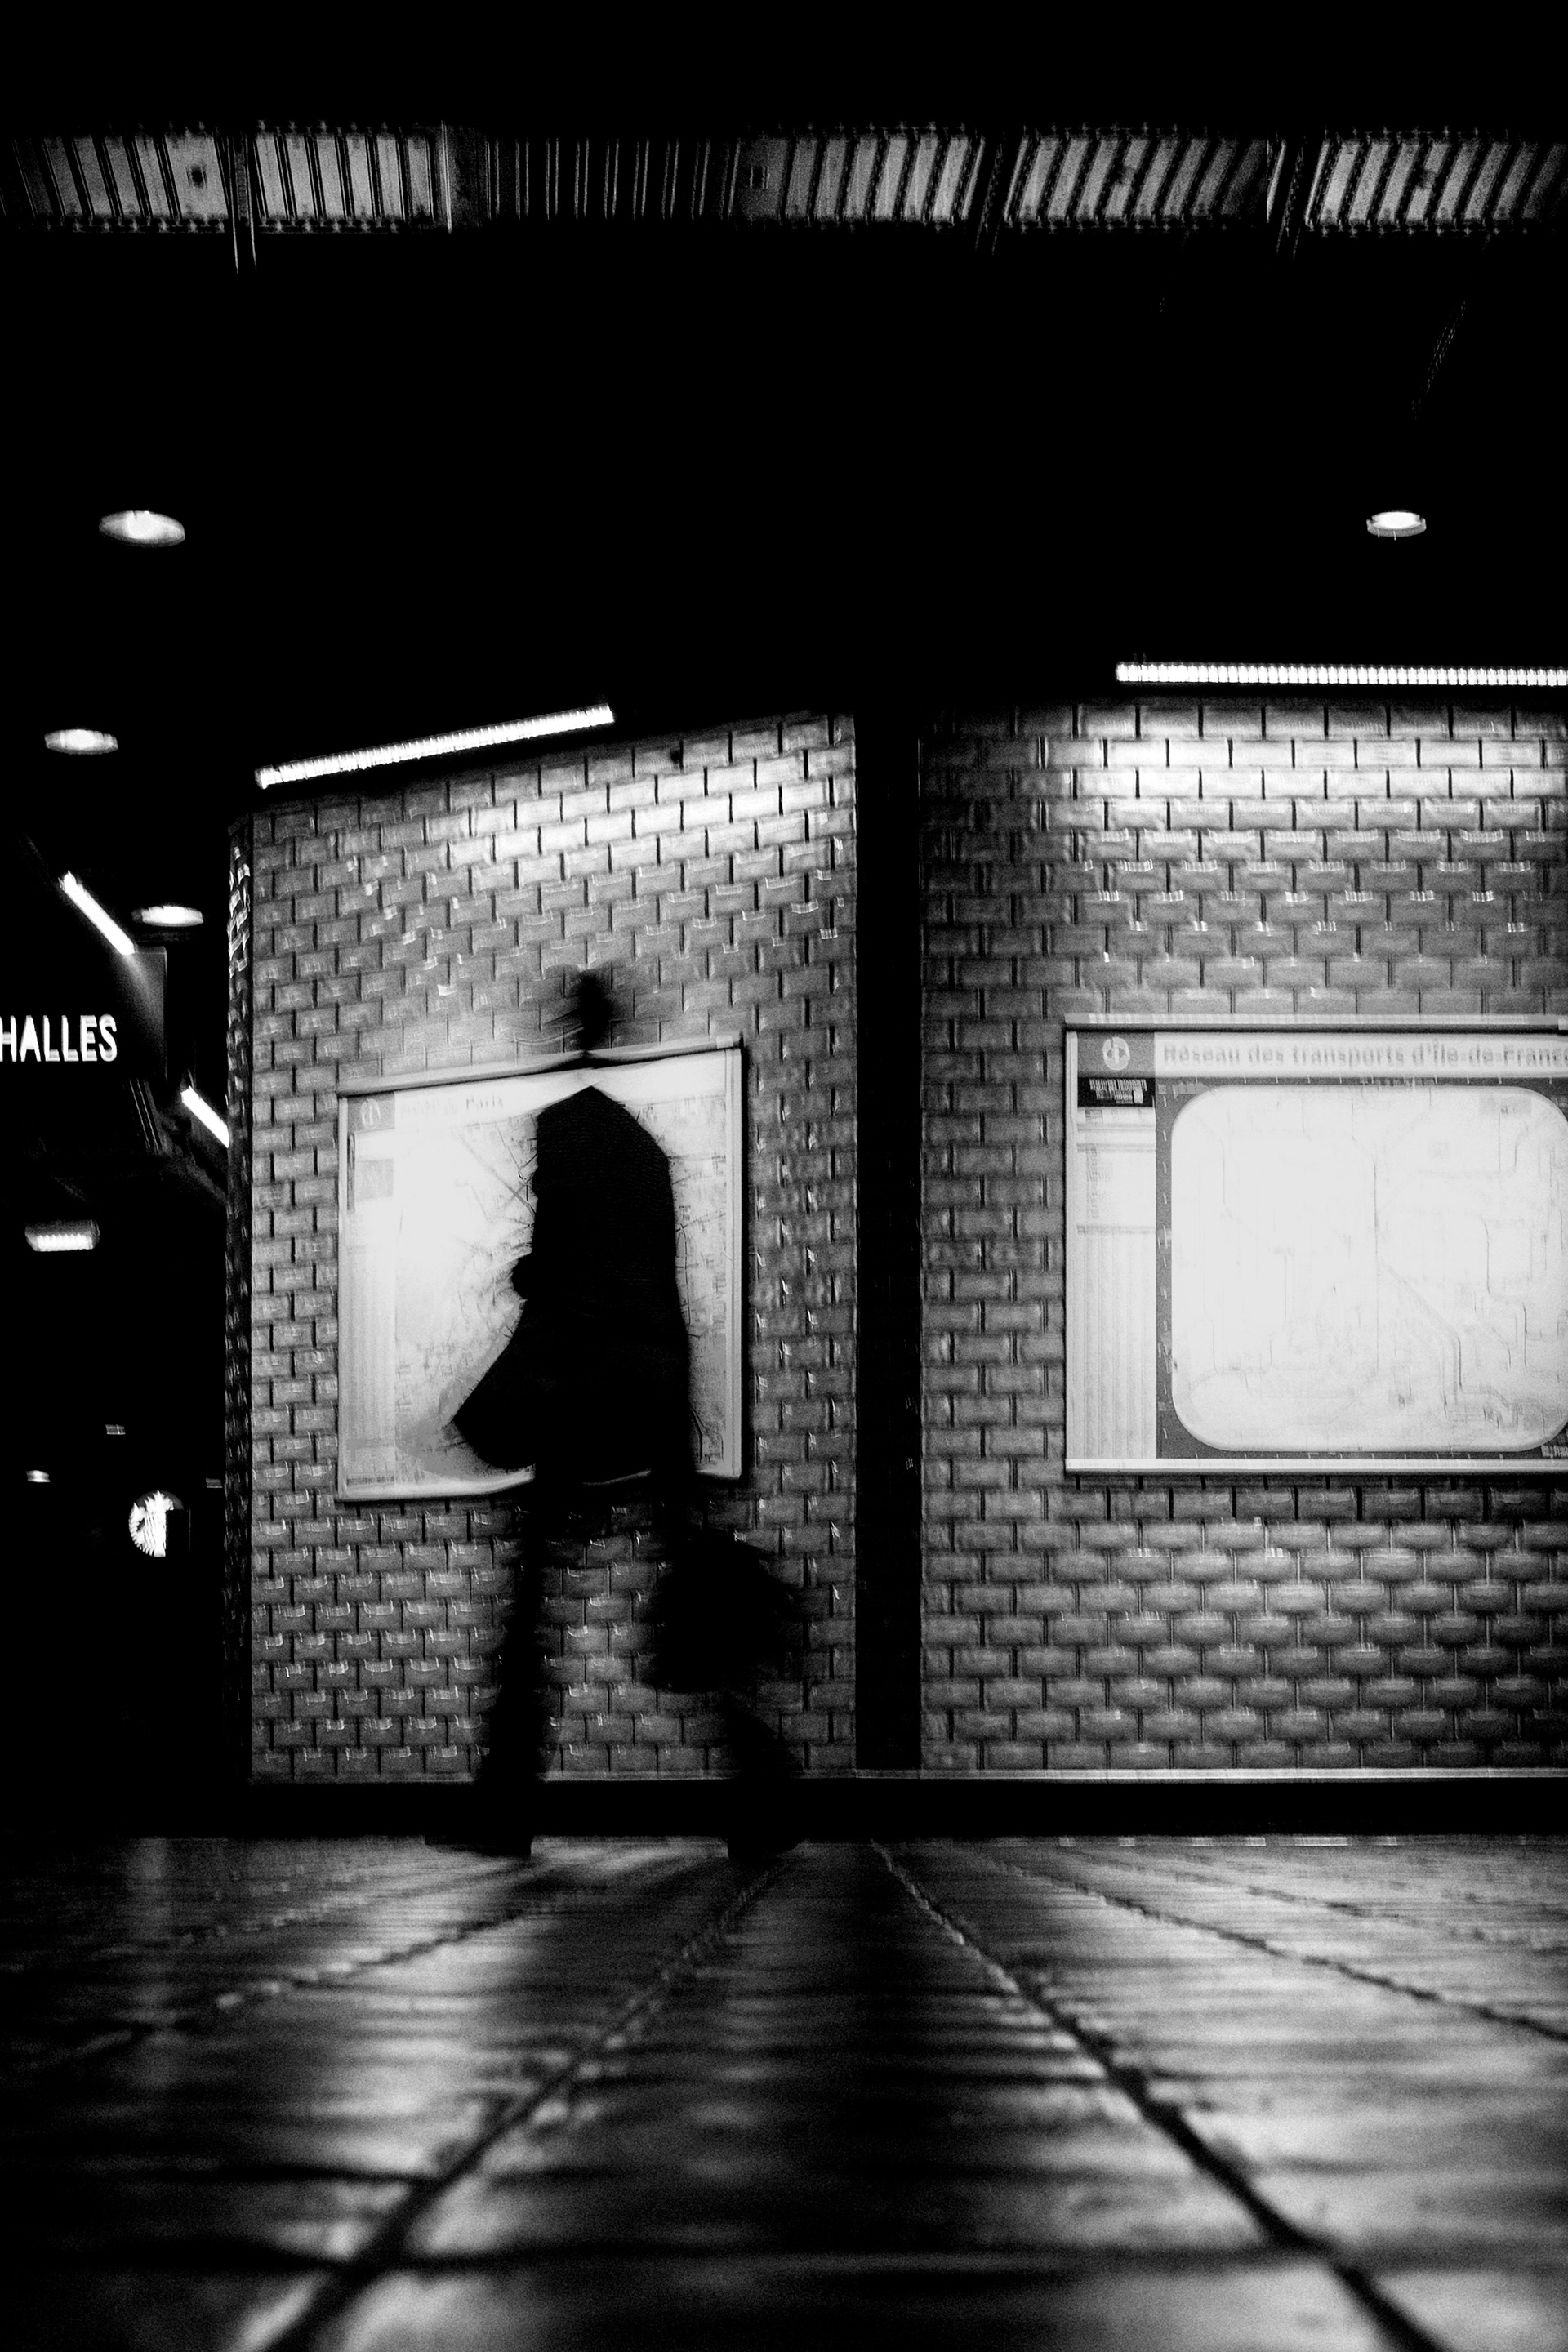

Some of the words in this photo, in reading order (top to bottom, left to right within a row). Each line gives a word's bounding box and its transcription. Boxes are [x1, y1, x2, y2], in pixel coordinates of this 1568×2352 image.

[0, 1013, 118, 1062] HALLES
[1249, 1043, 1285, 1065] des
[1293, 1045, 1405, 1069] transports
